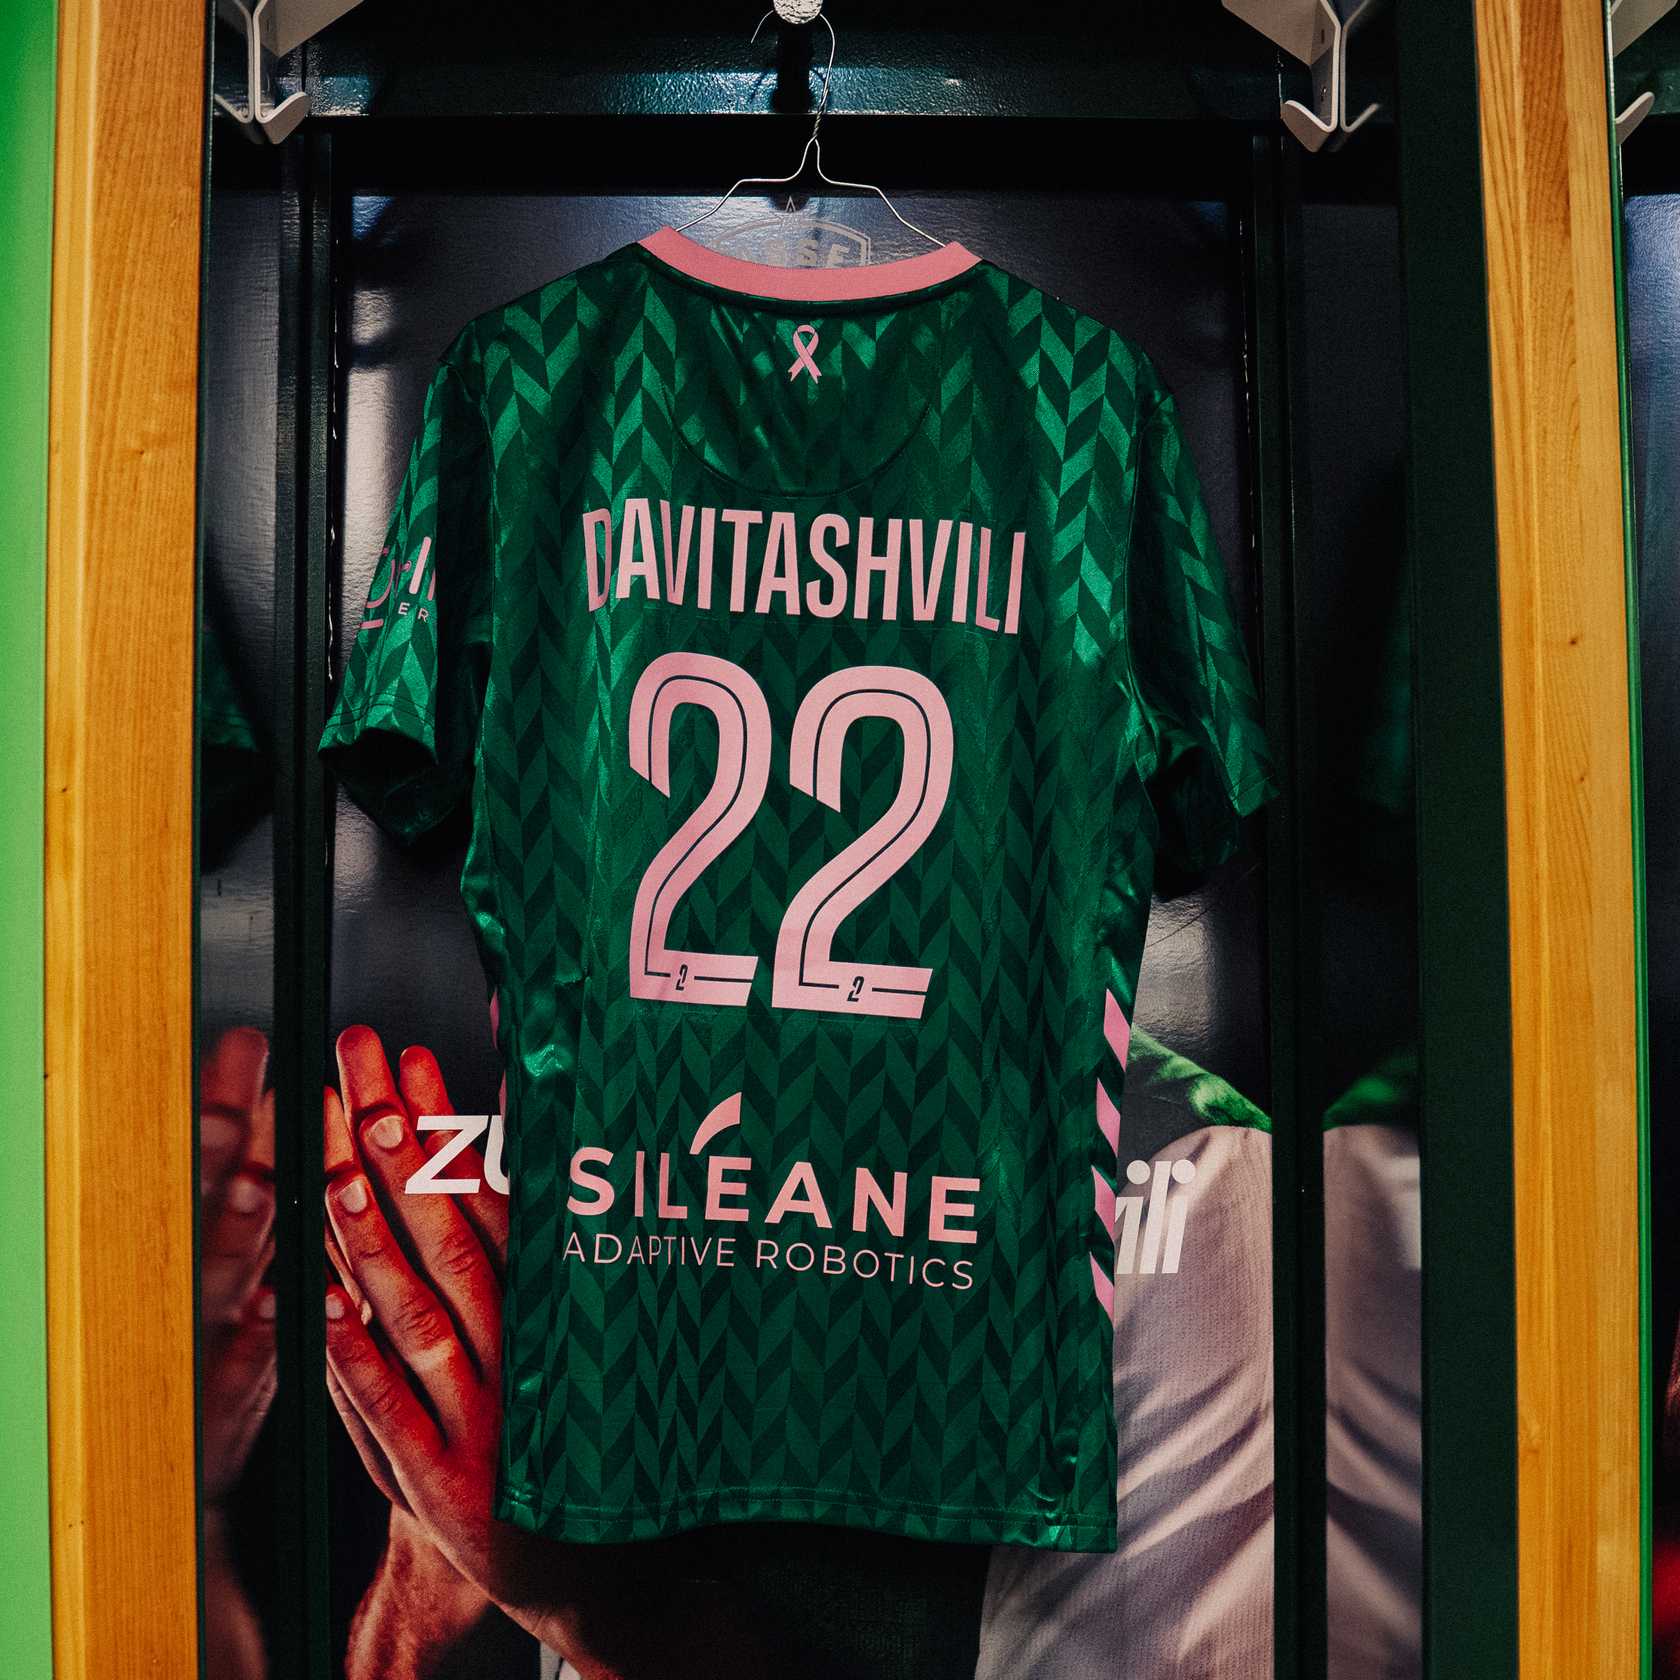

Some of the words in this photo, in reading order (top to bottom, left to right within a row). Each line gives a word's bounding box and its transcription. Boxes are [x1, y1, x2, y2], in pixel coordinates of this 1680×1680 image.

[583, 498, 1026, 634] DAVITASHVILI
[629, 652, 954, 1019] 22
[563, 1231, 737, 1267] ADAPTIVE
[756, 1239, 974, 1290] ROBOTICS
[1114, 1159, 1196, 1274] ili
